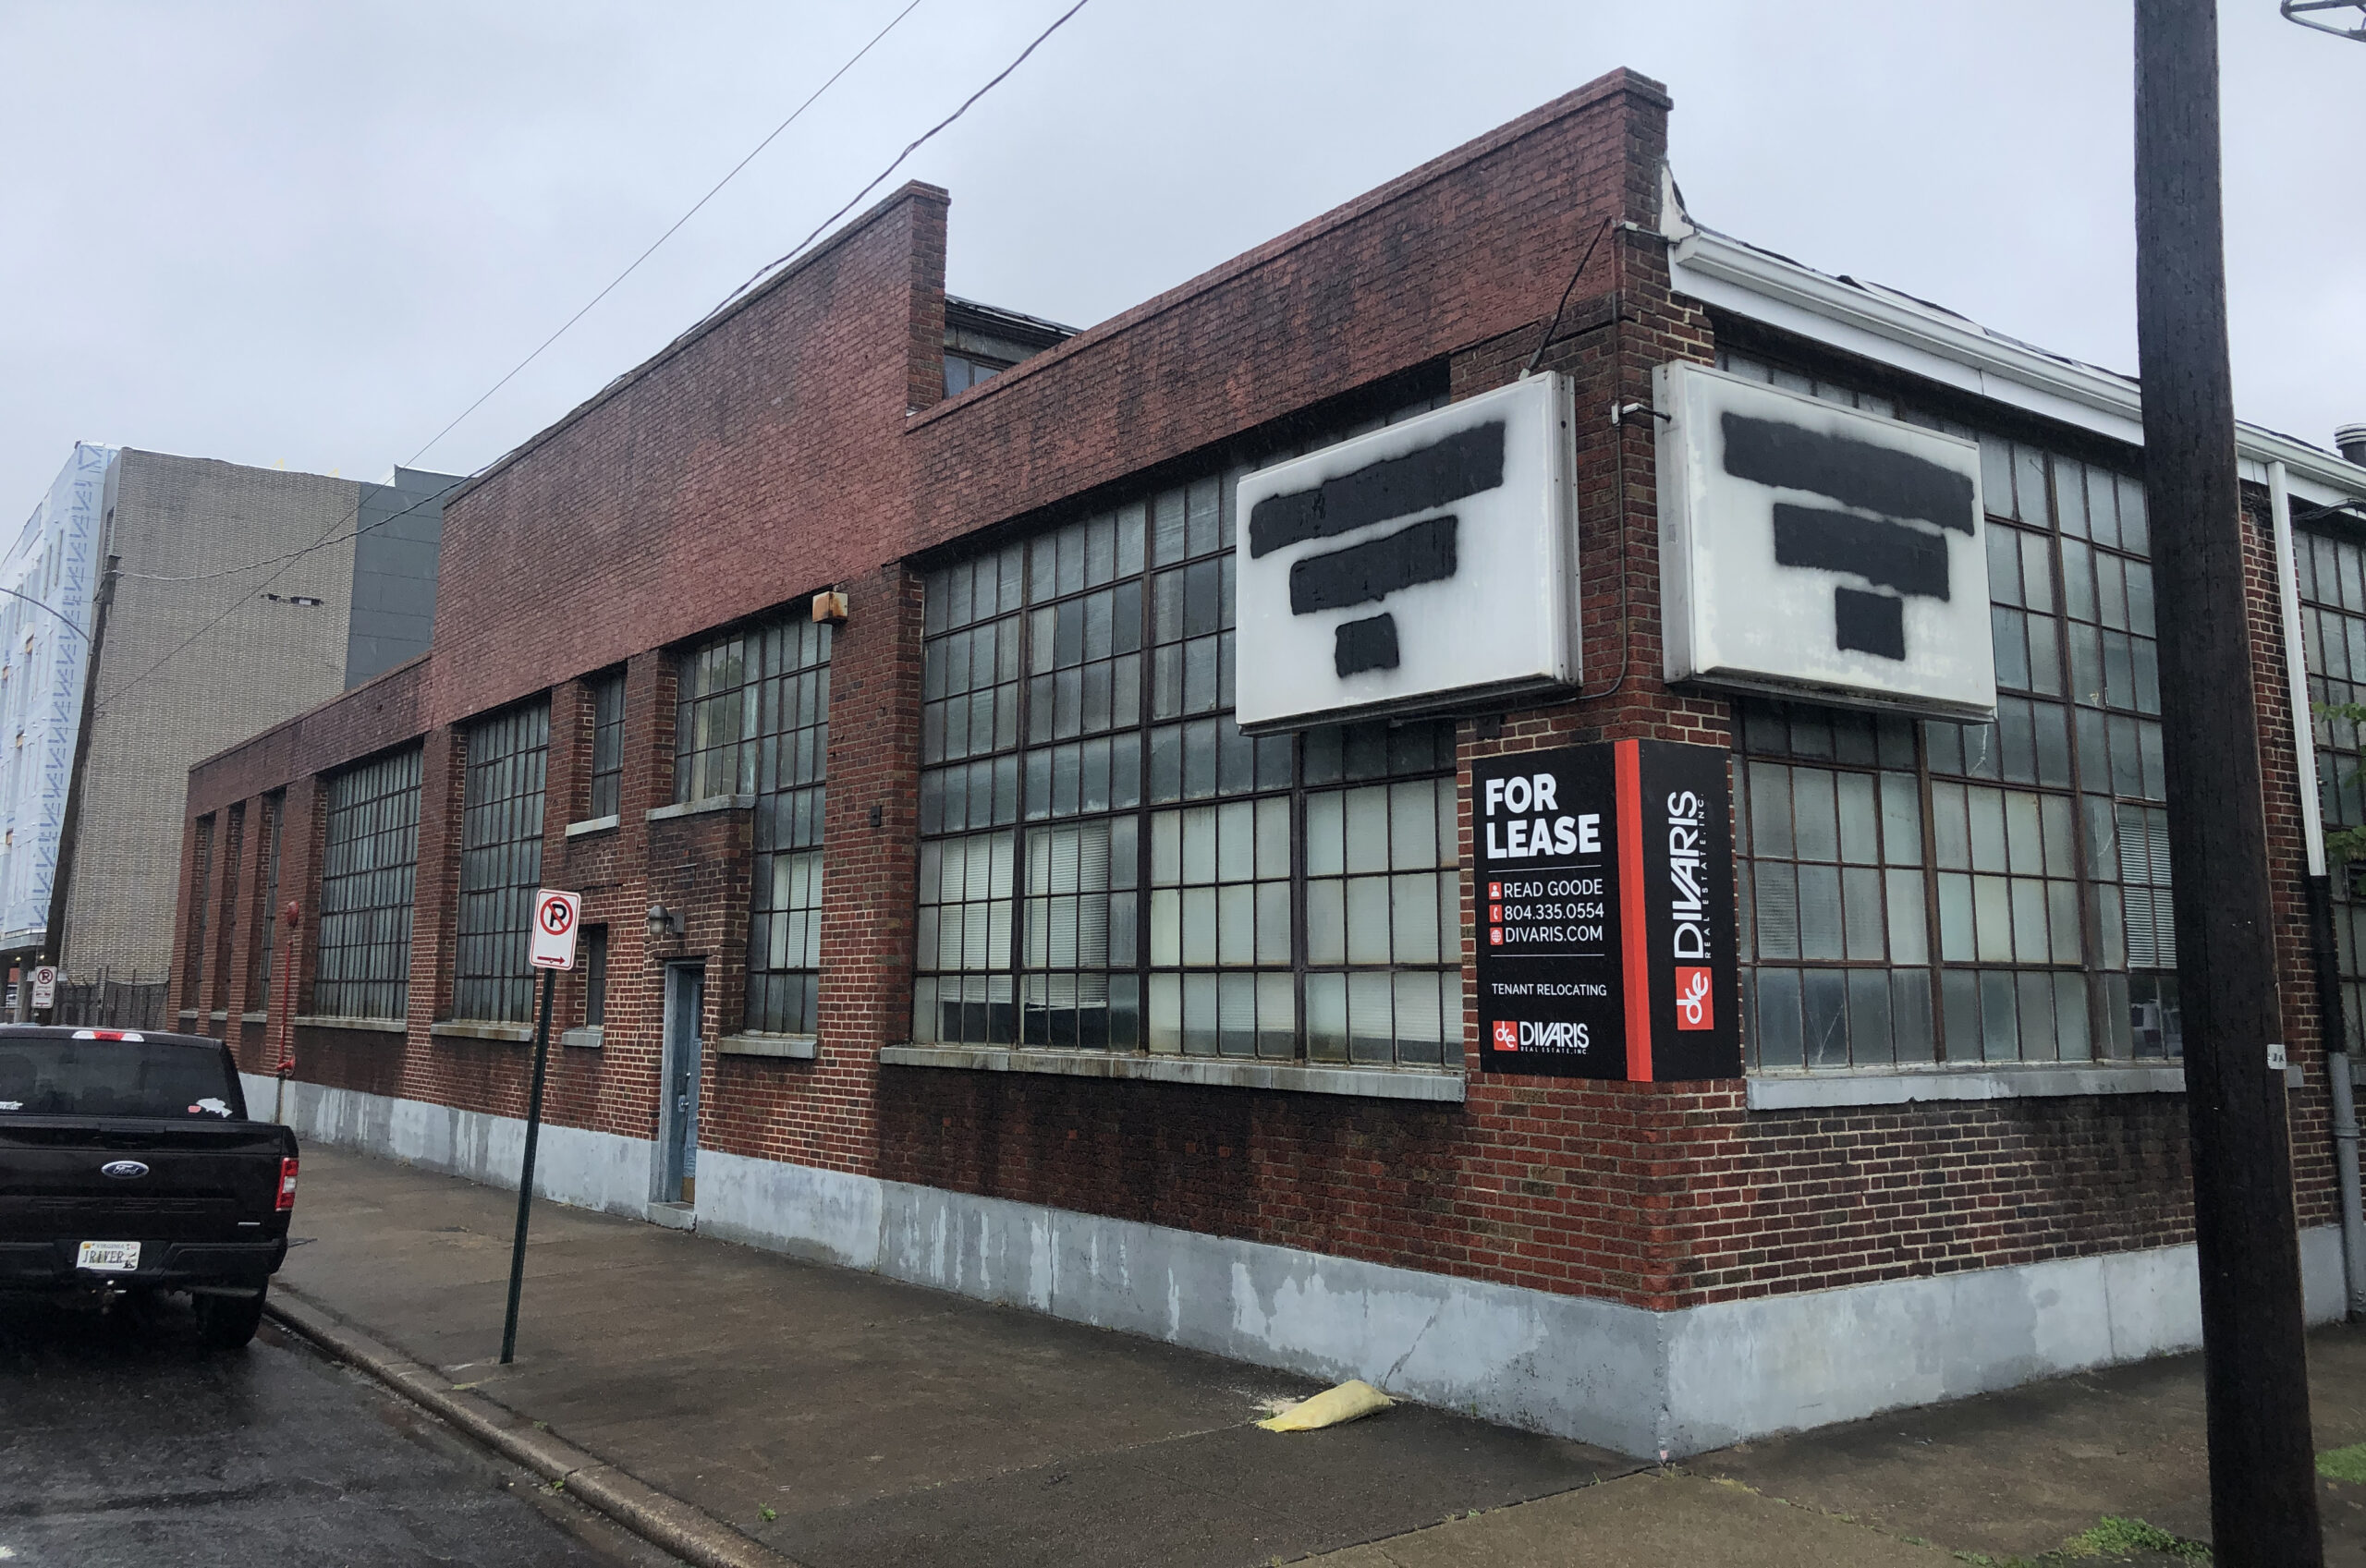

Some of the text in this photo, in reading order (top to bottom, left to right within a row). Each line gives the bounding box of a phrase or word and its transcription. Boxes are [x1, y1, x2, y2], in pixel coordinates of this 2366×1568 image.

[1486, 773, 1558, 816] FOR
[1487, 814, 1602, 859] LEASE
[1667, 790, 1704, 959] DIVARIS
[1504, 879, 1604, 898] READ GOODE
[1505, 902, 1604, 921] 804.335.0554
[1505, 925, 1603, 942] DIVARIS.COM
[1702, 917, 1712, 959] REAL
[1491, 983, 1607, 996] TENANT RELOCATING
[1519, 1021, 1590, 1049] DIVARIS
[113, 1164, 139, 1174] Ford
